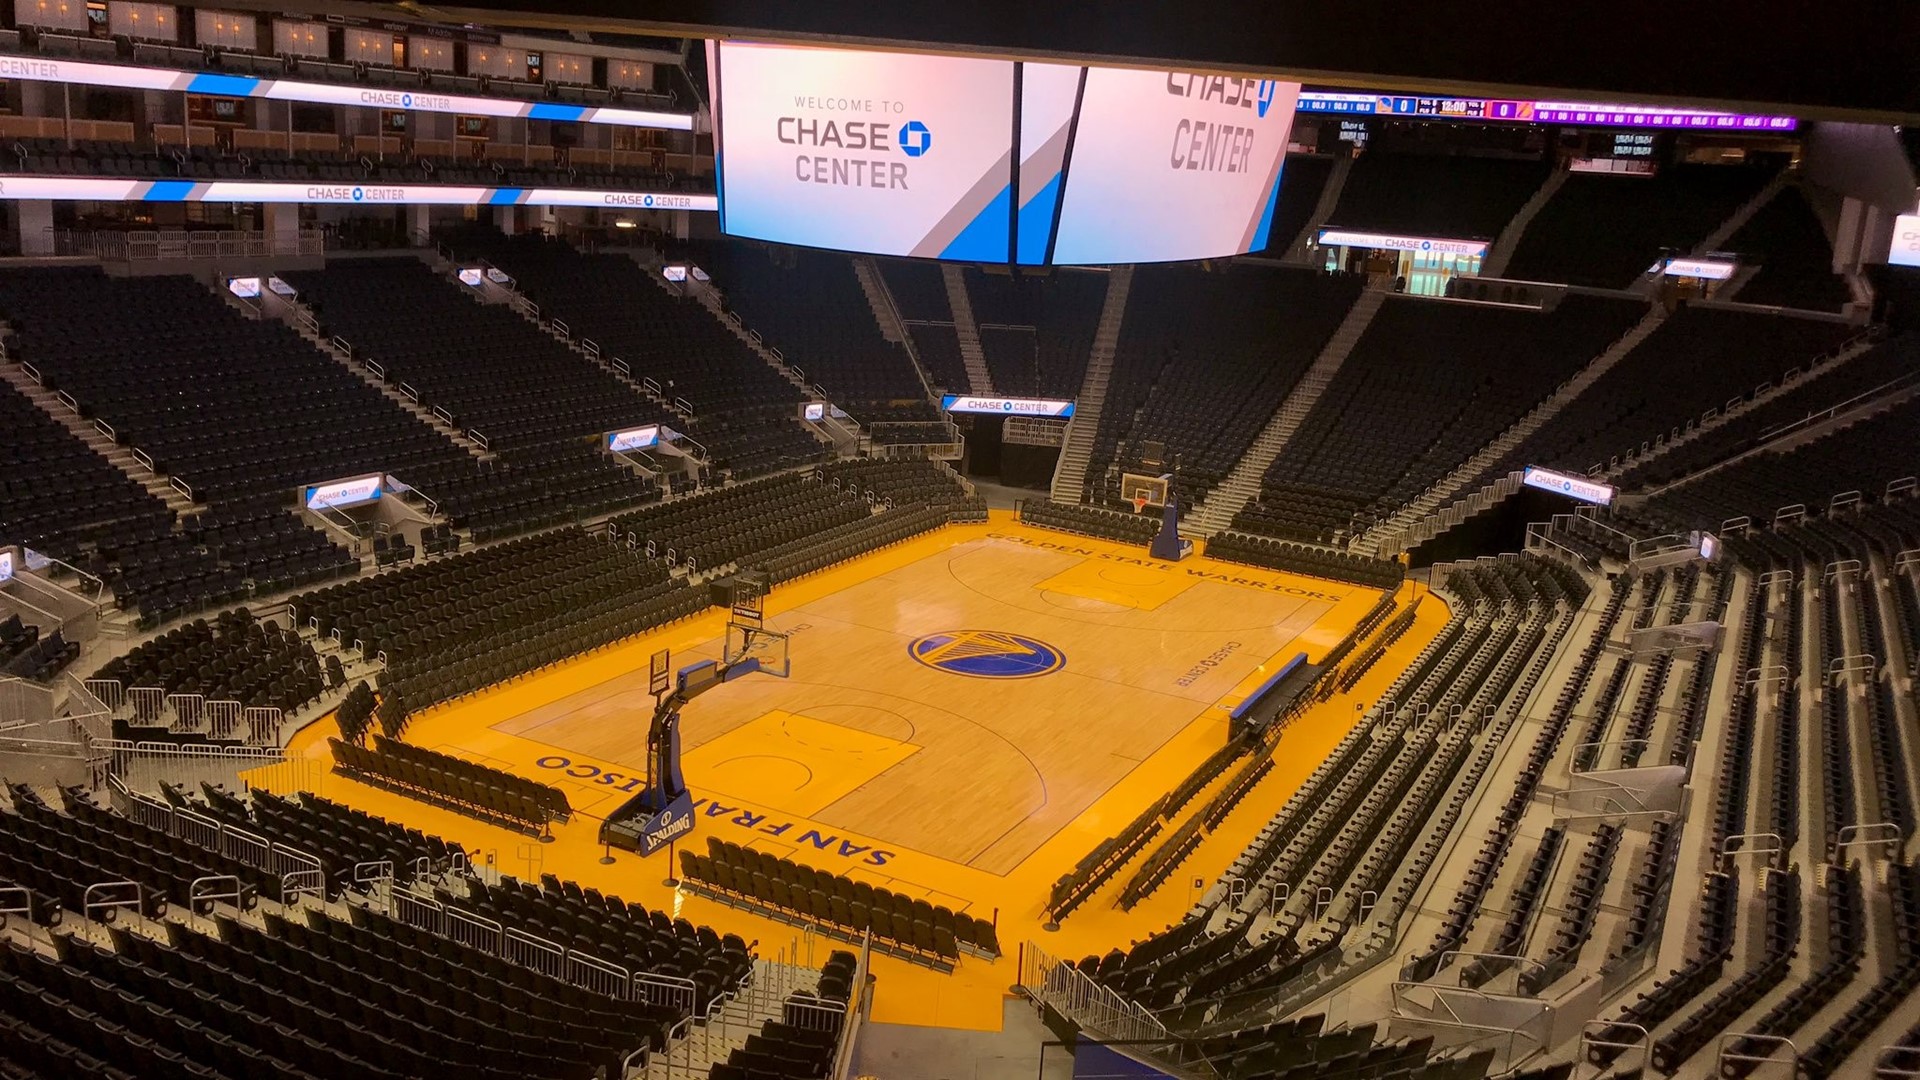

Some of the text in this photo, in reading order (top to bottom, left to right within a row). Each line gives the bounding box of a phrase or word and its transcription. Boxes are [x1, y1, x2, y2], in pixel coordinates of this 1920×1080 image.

[0, 60, 59, 78] CENTER
[361, 91, 450, 110] CHASE CENTER
[795, 96, 904, 114] WELCOME TO
[1441, 101, 1467, 112] 12:00
[777, 117, 891, 151] CHASE
[1171, 119, 1254, 173] CENTER
[796, 155, 909, 190] CENTER
[307, 188, 405, 201] CHASE CENTER
[604, 194, 691, 208] CHASE CENTER
[1385, 239, 1420, 249] CHASE
[1433, 242, 1468, 253] CENTER
[968, 400, 1048, 412] CHASE CENTER
[319, 486, 369, 501] CHASE CENTER
[1535, 474, 1601, 498] CHASE CENTER
[986, 533, 1342, 601] GOLDEN STATE WARRIORS
[537, 756, 896, 865] SAN FRAISCO
[647, 813, 690, 851] SPALDING
